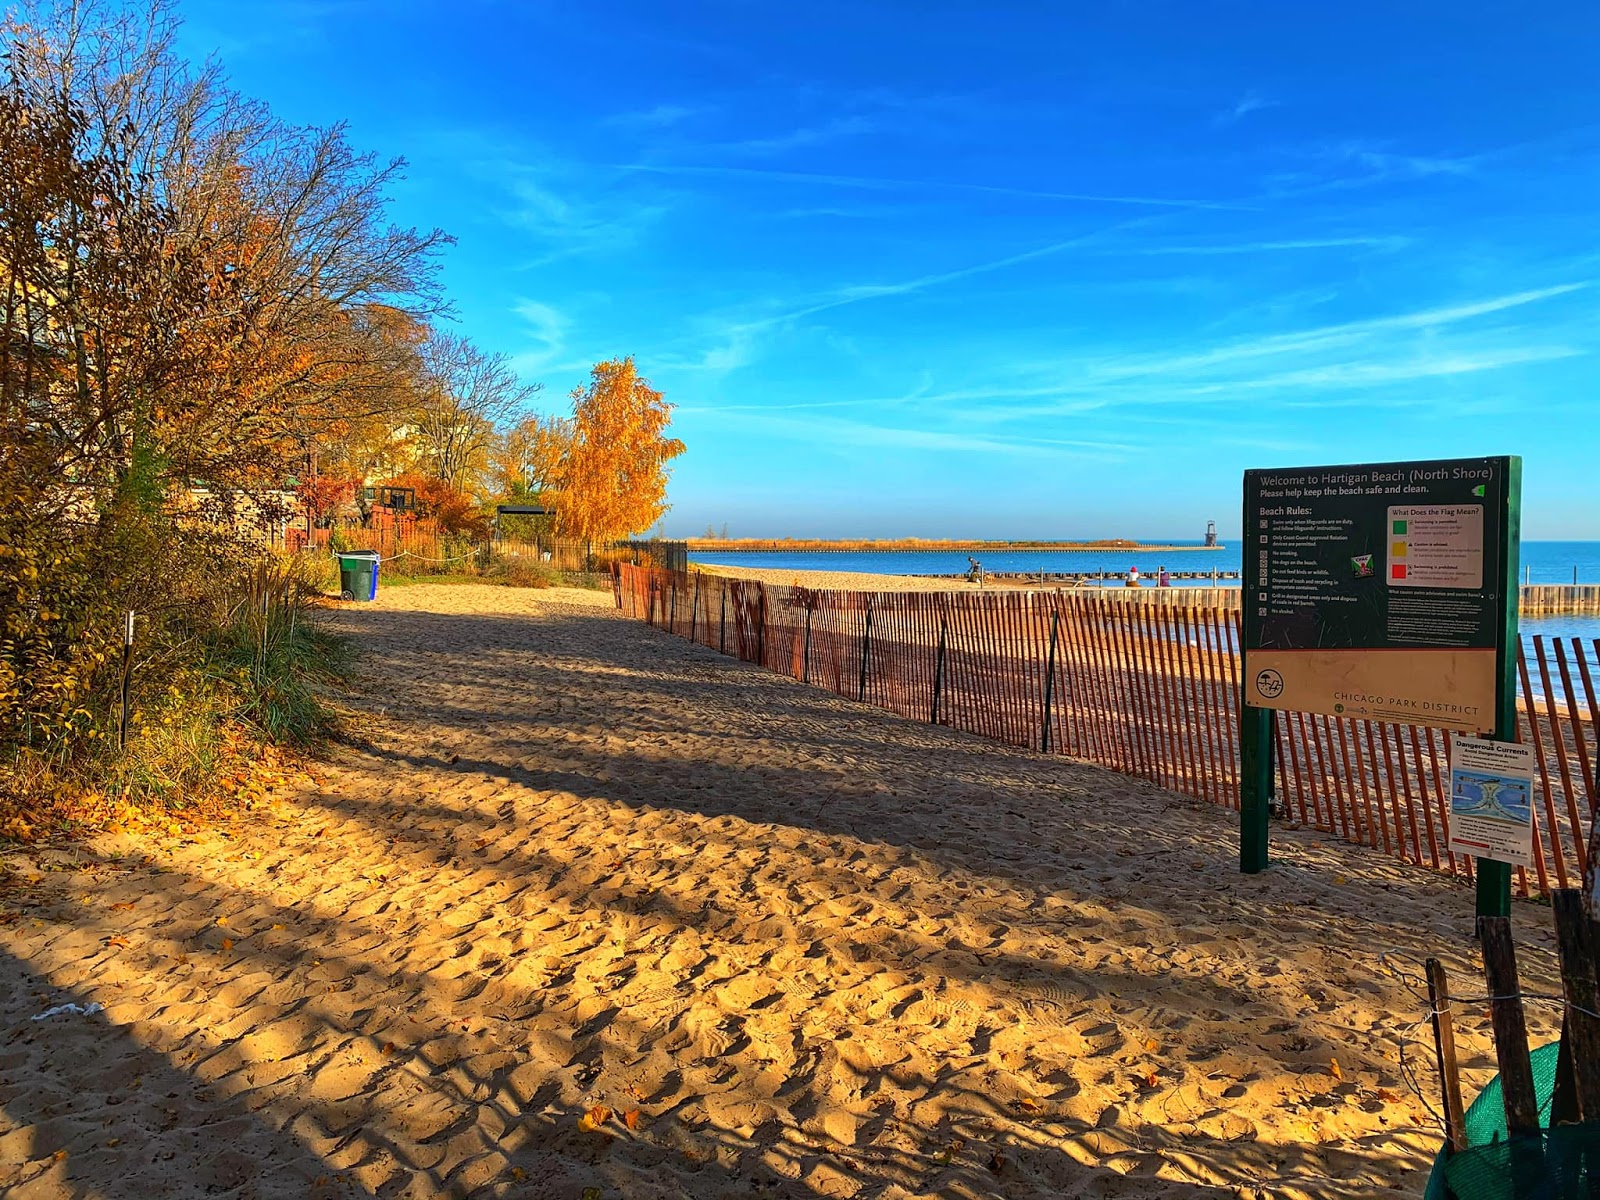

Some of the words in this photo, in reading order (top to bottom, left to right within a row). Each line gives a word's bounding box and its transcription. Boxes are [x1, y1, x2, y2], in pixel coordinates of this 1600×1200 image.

[1260, 476, 1305, 486] Welcome
[1308, 476, 1318, 484] to
[1321, 473, 1368, 486] Hartigan
[1372, 470, 1404, 481] Beach
[1410, 468, 1448, 483] (North
[1453, 467, 1493, 481] Shore)
[1260, 489, 1284, 498] Please
[1286, 488, 1302, 499] help
[1304, 488, 1322, 498] keep
[1324, 487, 1337, 496] the
[1339, 486, 1363, 495] beach
[1365, 485, 1382, 494] safe
[1385, 485, 1400, 494] and
[1403, 485, 1429, 493] clean.
[1260, 506, 1284, 516] Beach
[1287, 506, 1312, 515] Rules:
[1334, 692, 1384, 704] CHICAGO
[1390, 698, 1417, 708] PARK
[1423, 702, 1479, 715] DISTRICT
[1456, 741, 1494, 751] Dangerous
[1496, 746, 1528, 755] Currents
